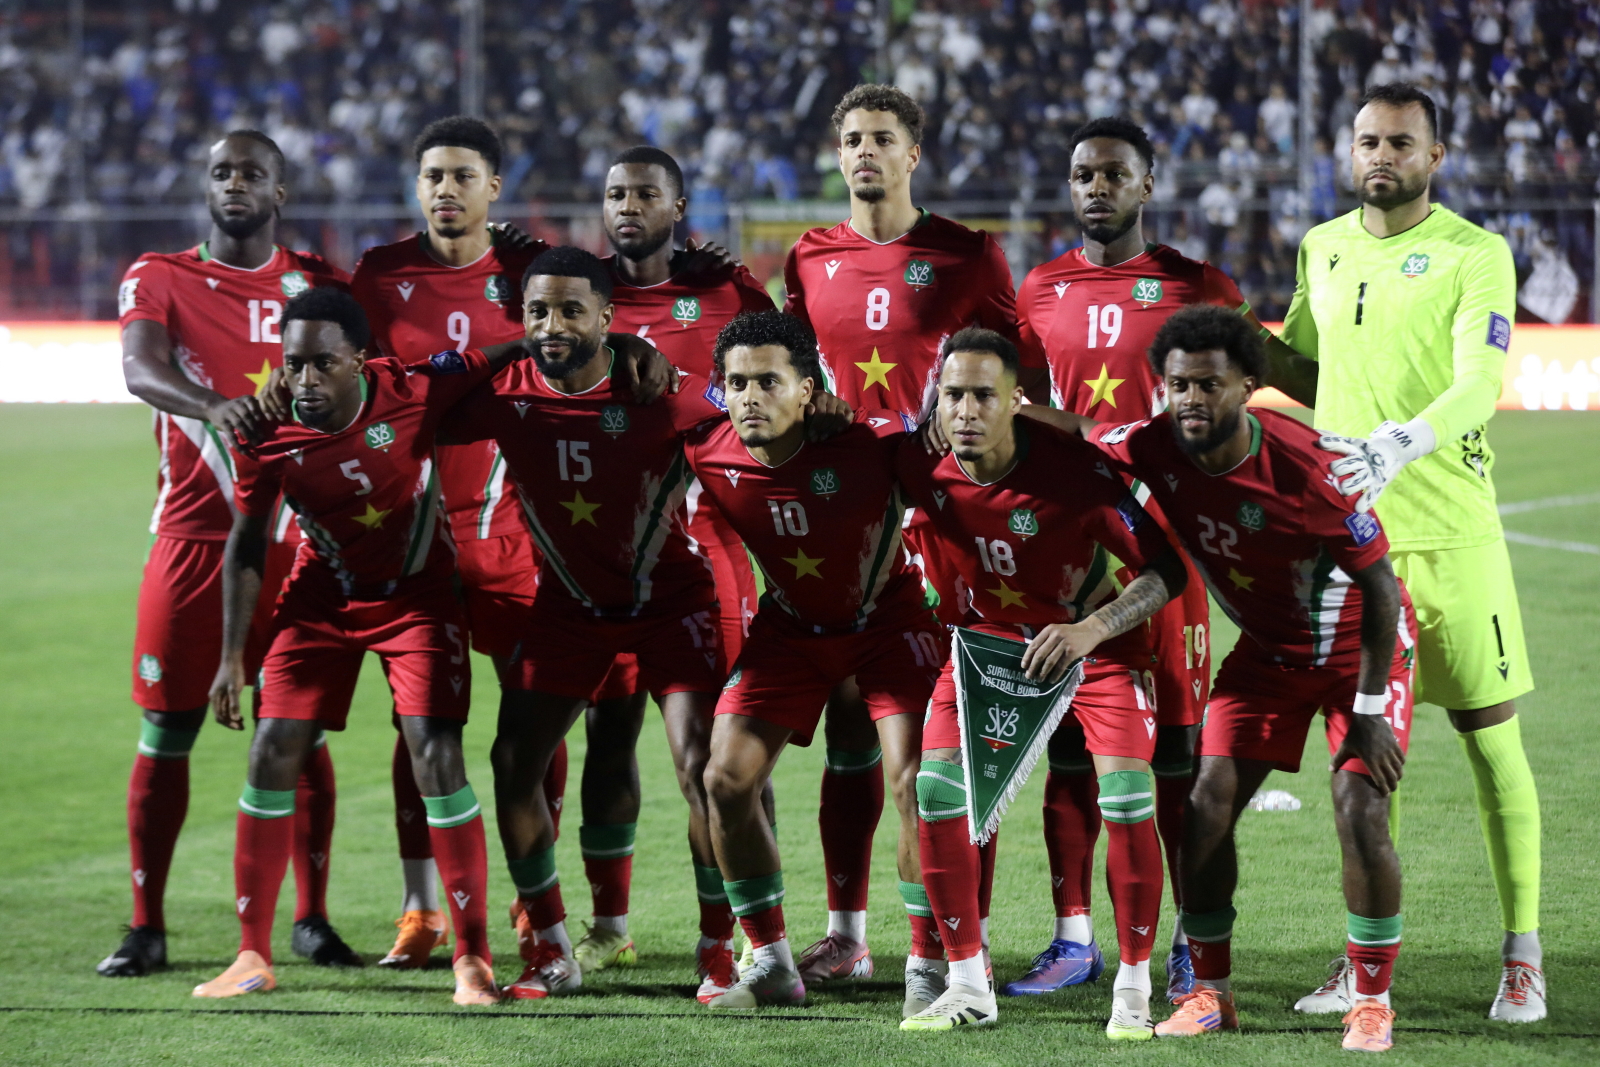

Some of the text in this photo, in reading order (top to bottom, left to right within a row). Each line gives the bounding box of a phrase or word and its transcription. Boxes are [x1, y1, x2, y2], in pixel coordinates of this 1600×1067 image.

[909, 263, 930, 283] SVB
[1137, 280, 1159, 301] SVB
[247, 299, 282, 343] 12
[676, 298, 697, 319] SVB
[866, 288, 890, 330] 8
[1355, 282, 1368, 325] 1
[447, 311, 470, 353] 9
[1087, 304, 1123, 348] 19
[367, 423, 391, 445] SVB
[604, 408, 625, 431] SVB
[1388, 428, 1412, 448] HM
[338, 458, 373, 496] 5
[556, 440, 593, 482] 15
[813, 471, 835, 493] SVB
[767, 500, 809, 536] 10
[1013, 511, 1033, 533] SVB
[975, 536, 1017, 576] 18
[1197, 514, 1242, 561] 22
[445, 624, 464, 665] 5
[682, 610, 717, 648] 15
[1183, 623, 1207, 669] 19
[1492, 614, 1505, 657] 1
[903, 631, 941, 668] 10
[981, 676, 1040, 698] VOETBAL BOND
[1129, 669, 1158, 714] 18
[985, 703, 1020, 739] SVB
